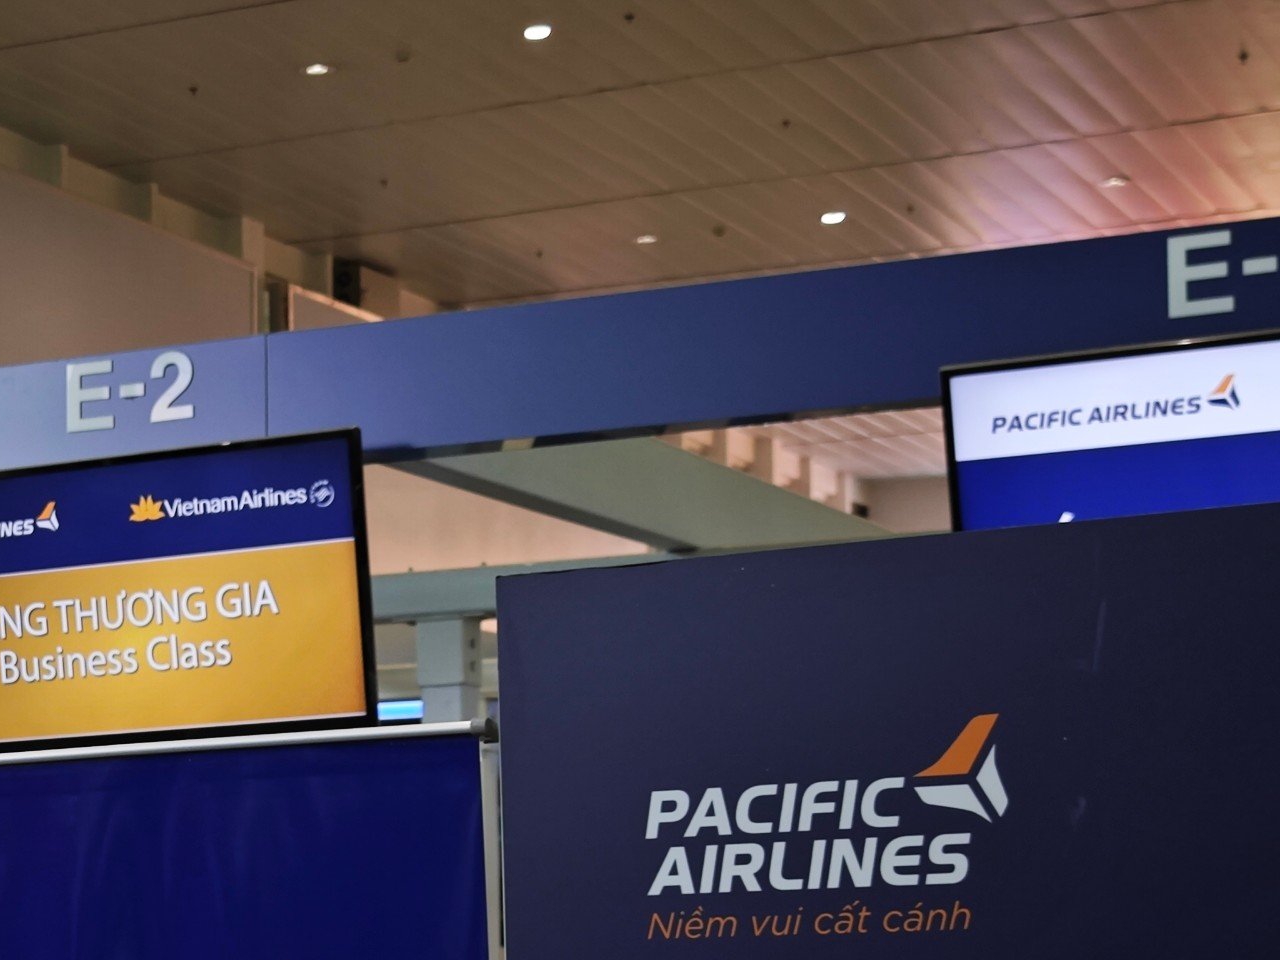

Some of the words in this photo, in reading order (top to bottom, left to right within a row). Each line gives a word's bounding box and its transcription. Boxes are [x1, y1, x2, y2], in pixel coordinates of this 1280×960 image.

[1167, 229, 1278, 320] E-
[65, 350, 195, 434] E-2
[991, 408, 1083, 434] PACIFIC
[1087, 396, 1202, 425] AIRLINES
[163, 494, 239, 520] Vietnam
[238, 485, 308, 510] Airlines
[53, 586, 208, 632] THƯƠNG
[216, 579, 280, 619] GIA
[145, 634, 233, 673] Class
[645, 776, 905, 840] PACIFIC
[646, 832, 971, 896] AIRLINES
[647, 903, 738, 940] Niềm
[752, 905, 801, 936] vui
[814, 900, 868, 936] cất
[882, 900, 972, 934] cánh
